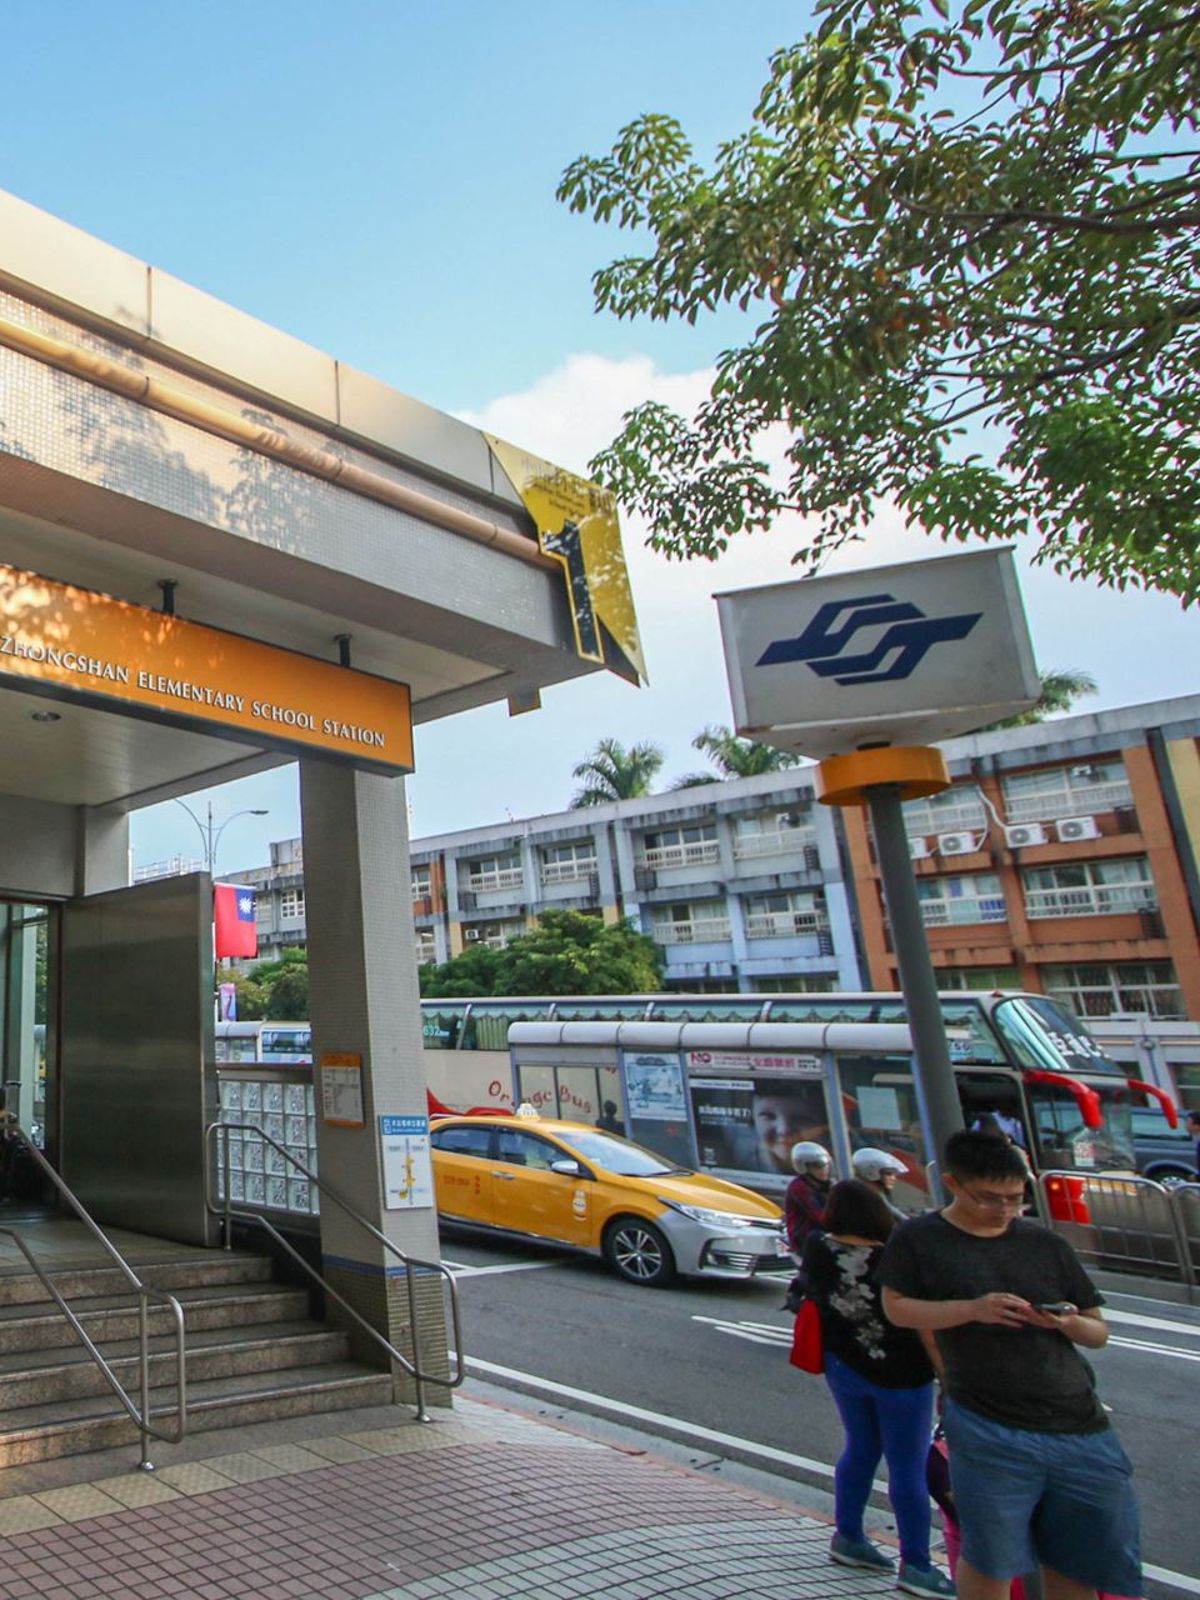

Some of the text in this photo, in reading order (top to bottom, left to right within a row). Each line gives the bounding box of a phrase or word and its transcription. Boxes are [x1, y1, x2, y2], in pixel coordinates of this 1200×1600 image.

[0, 635, 385, 747] ZHONGSHAN ELEMENTARY SCHOOL STATION
[489, 1081, 552, 1109] Orge
